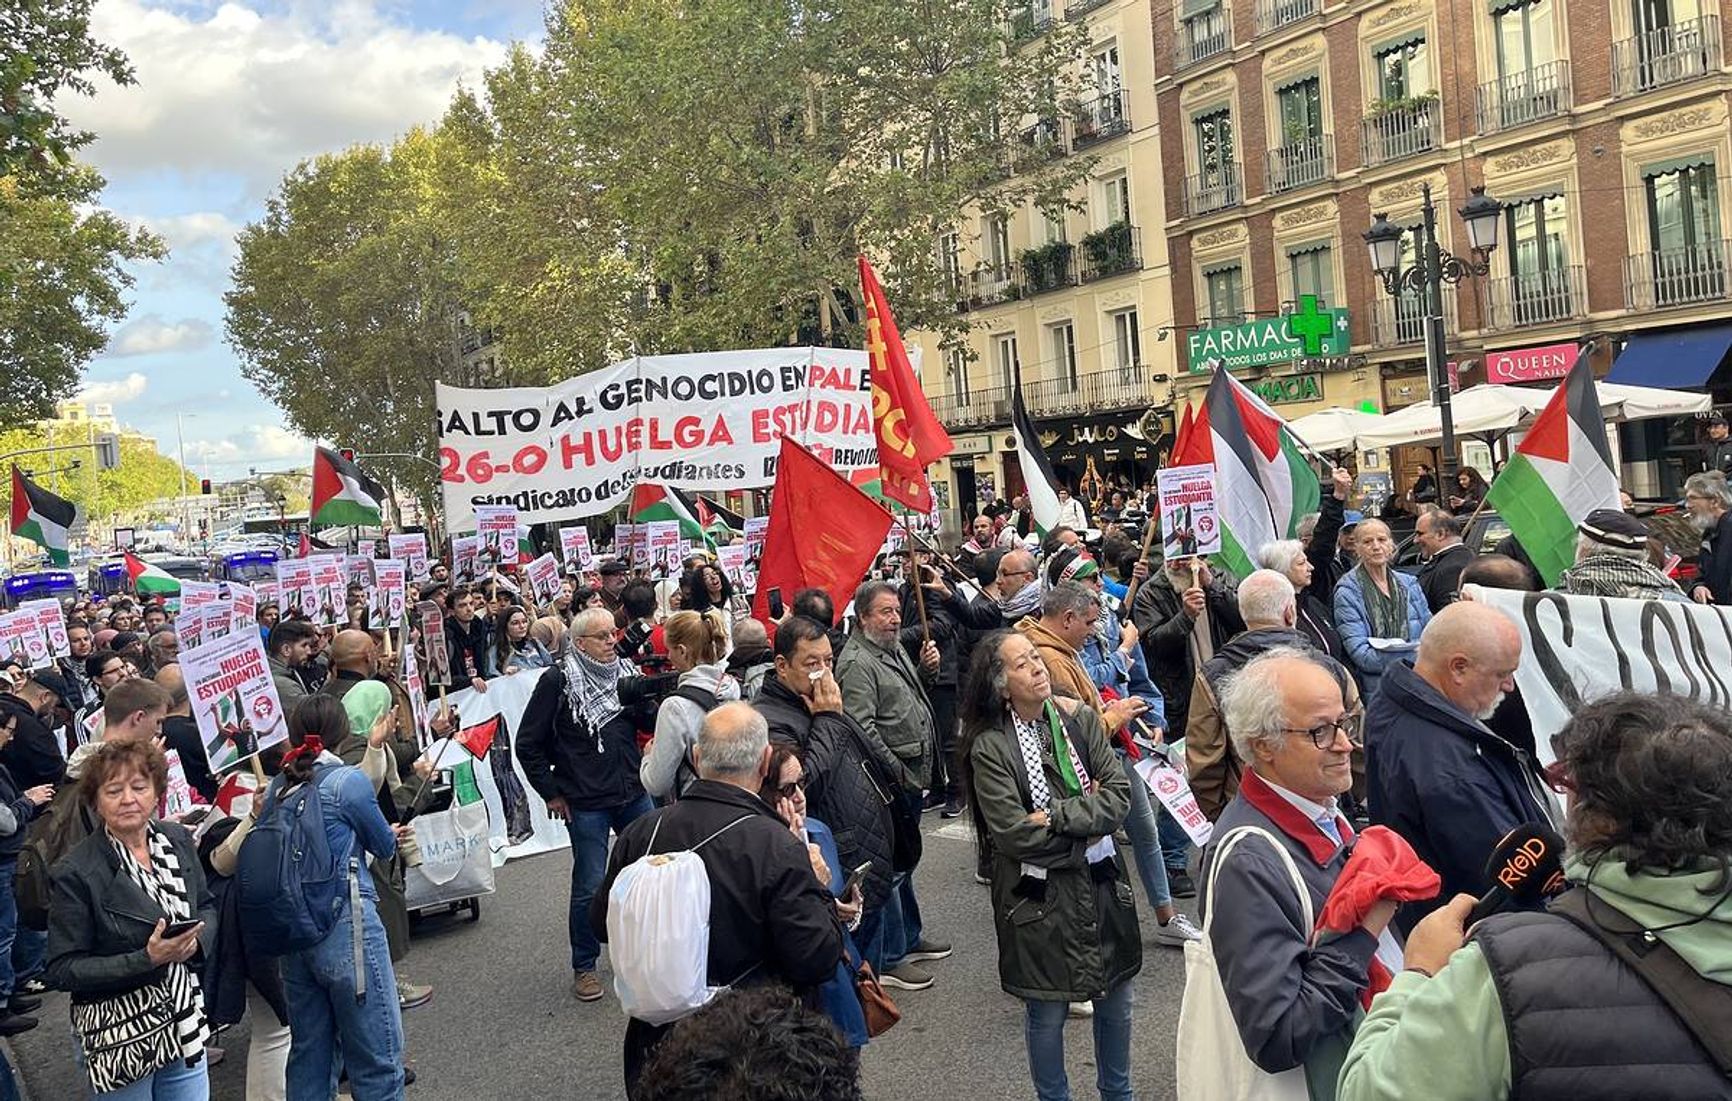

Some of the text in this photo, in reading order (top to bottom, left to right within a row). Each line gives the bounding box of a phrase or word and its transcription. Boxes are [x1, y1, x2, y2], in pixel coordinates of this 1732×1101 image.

[1189, 321, 1300, 357] FARMAC
[1253, 352, 1267, 363] LOS
[1291, 346, 1303, 358] DE
[1497, 352, 1566, 380] QUEEN
[1534, 367, 1567, 377] NAILS
[599, 369, 775, 411] GENOCIDIO
[780, 365, 807, 393] EN
[808, 365, 871, 392] PALE
[1254, 376, 1320, 398] MACIA
[561, 413, 734, 467] HUELGA
[752, 400, 874, 443] ESTUDIA
[1181, 480, 1213, 493] HUELGA
[220, 648, 261, 675] HUELGA
[196, 662, 265, 701] ESTUDIANTIL
[427, 833, 479, 857] MARK
